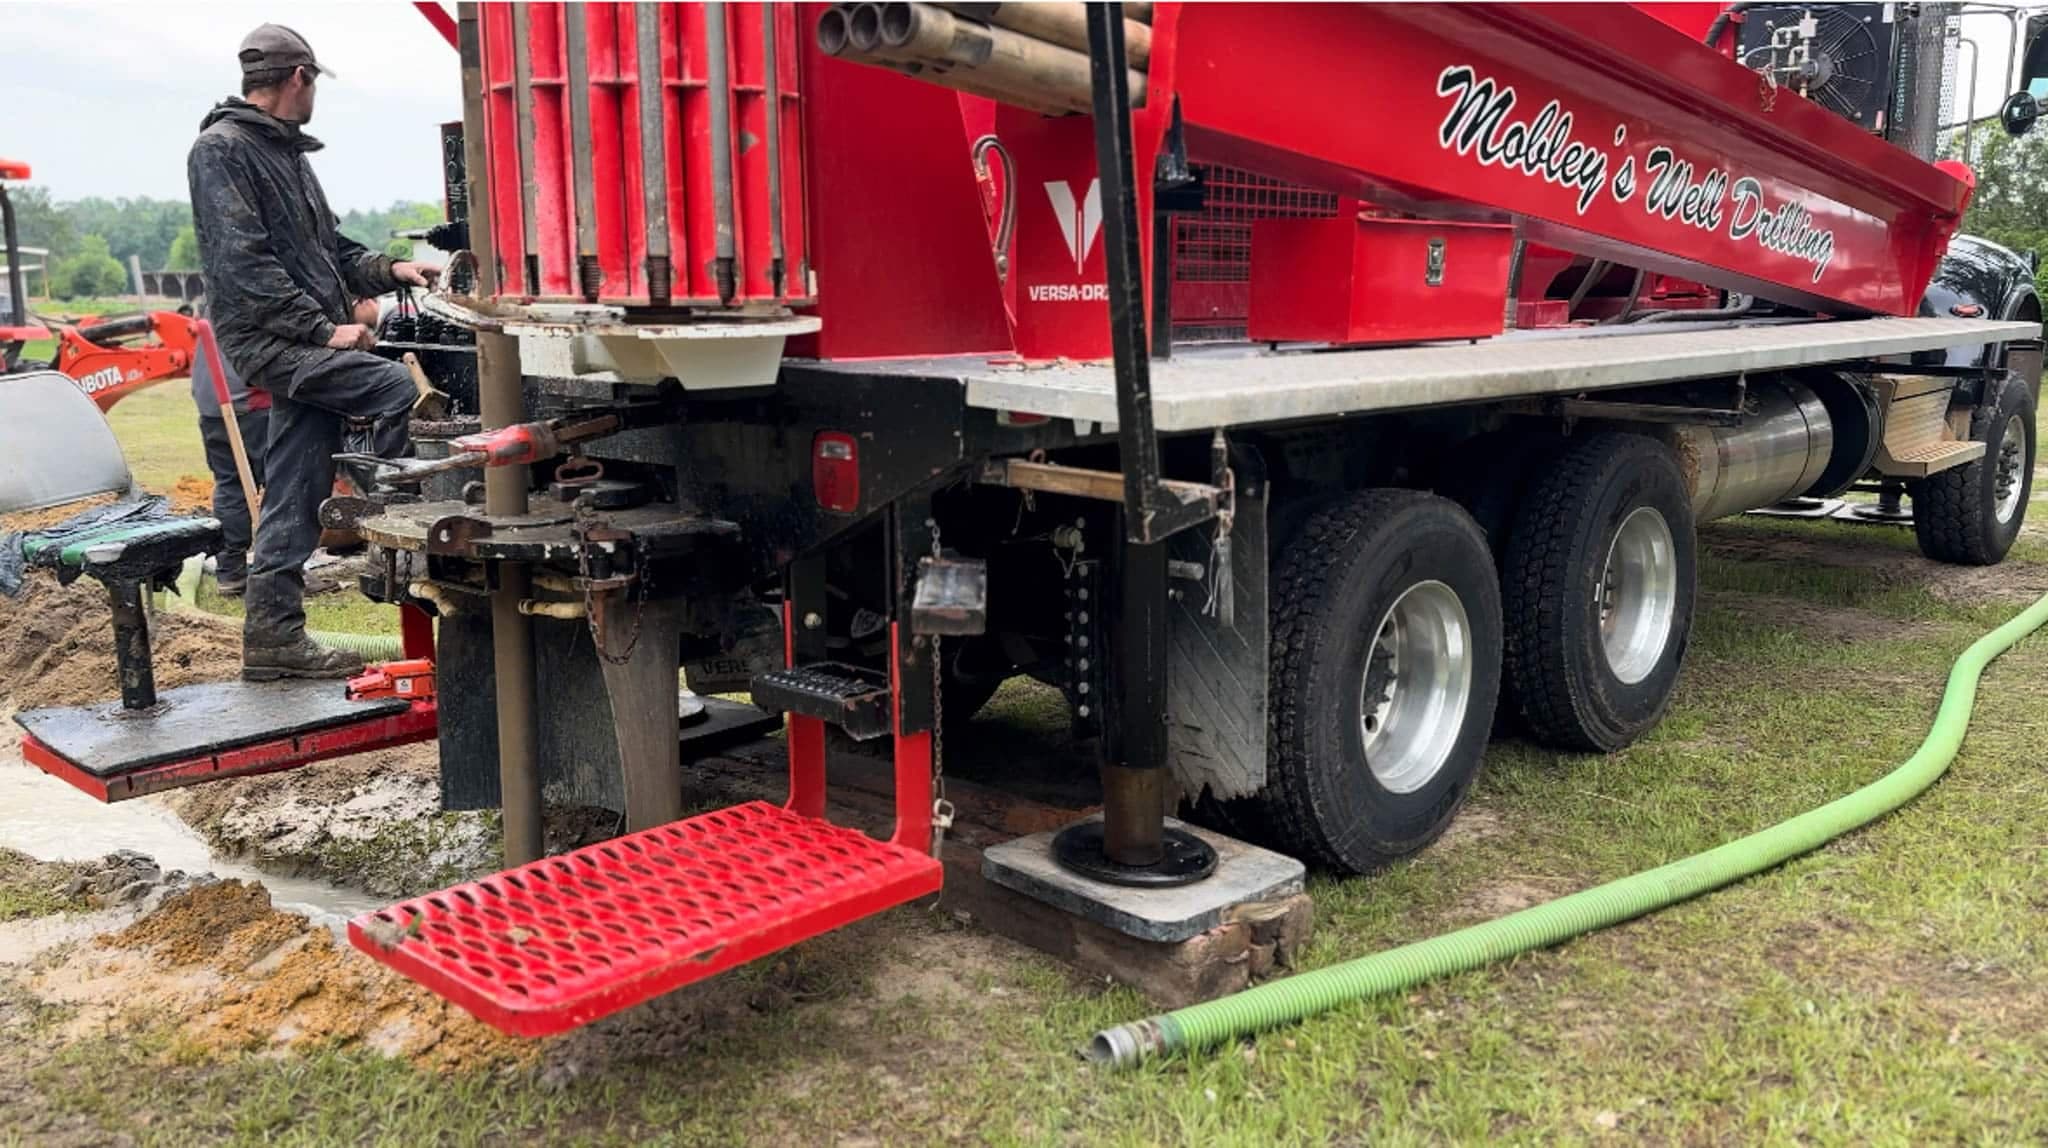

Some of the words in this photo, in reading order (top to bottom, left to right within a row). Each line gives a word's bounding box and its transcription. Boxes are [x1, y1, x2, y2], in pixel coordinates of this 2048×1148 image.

[1437, 65, 1636, 215] Mobley's
[1647, 146, 1728, 231] Well
[1729, 176, 1834, 284] Drilling
